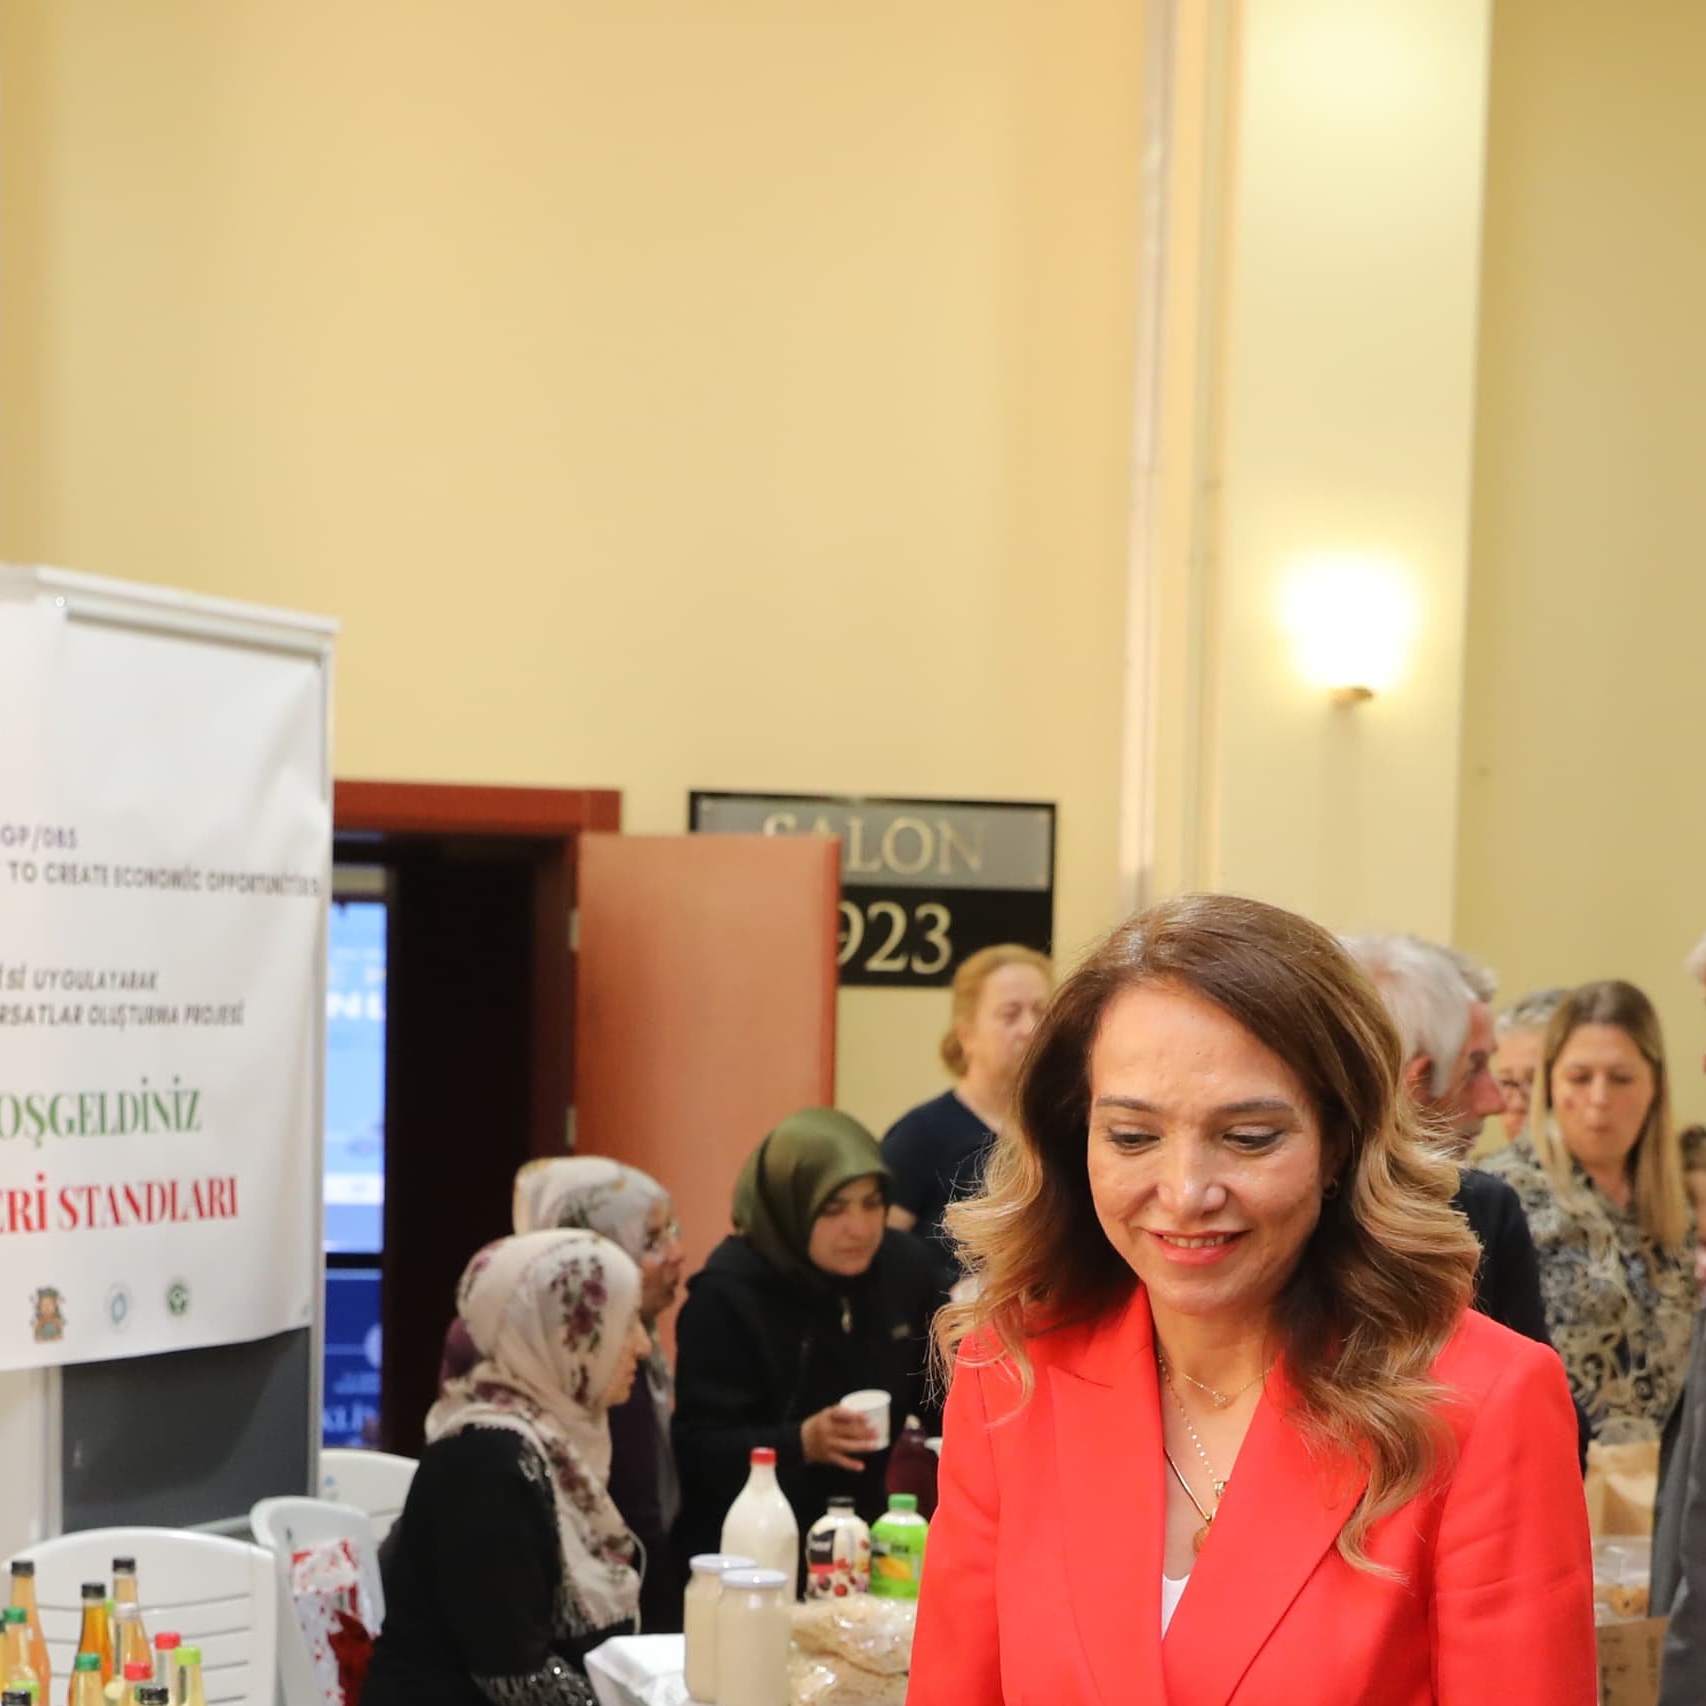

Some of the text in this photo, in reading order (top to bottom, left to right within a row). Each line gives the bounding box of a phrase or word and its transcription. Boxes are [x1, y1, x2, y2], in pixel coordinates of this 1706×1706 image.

[9, 860, 38, 885] TO
[44, 862, 111, 888] CREATE
[33, 968, 159, 991] UYGULAYARAK
[57, 1175, 239, 1233] STANDLARI
